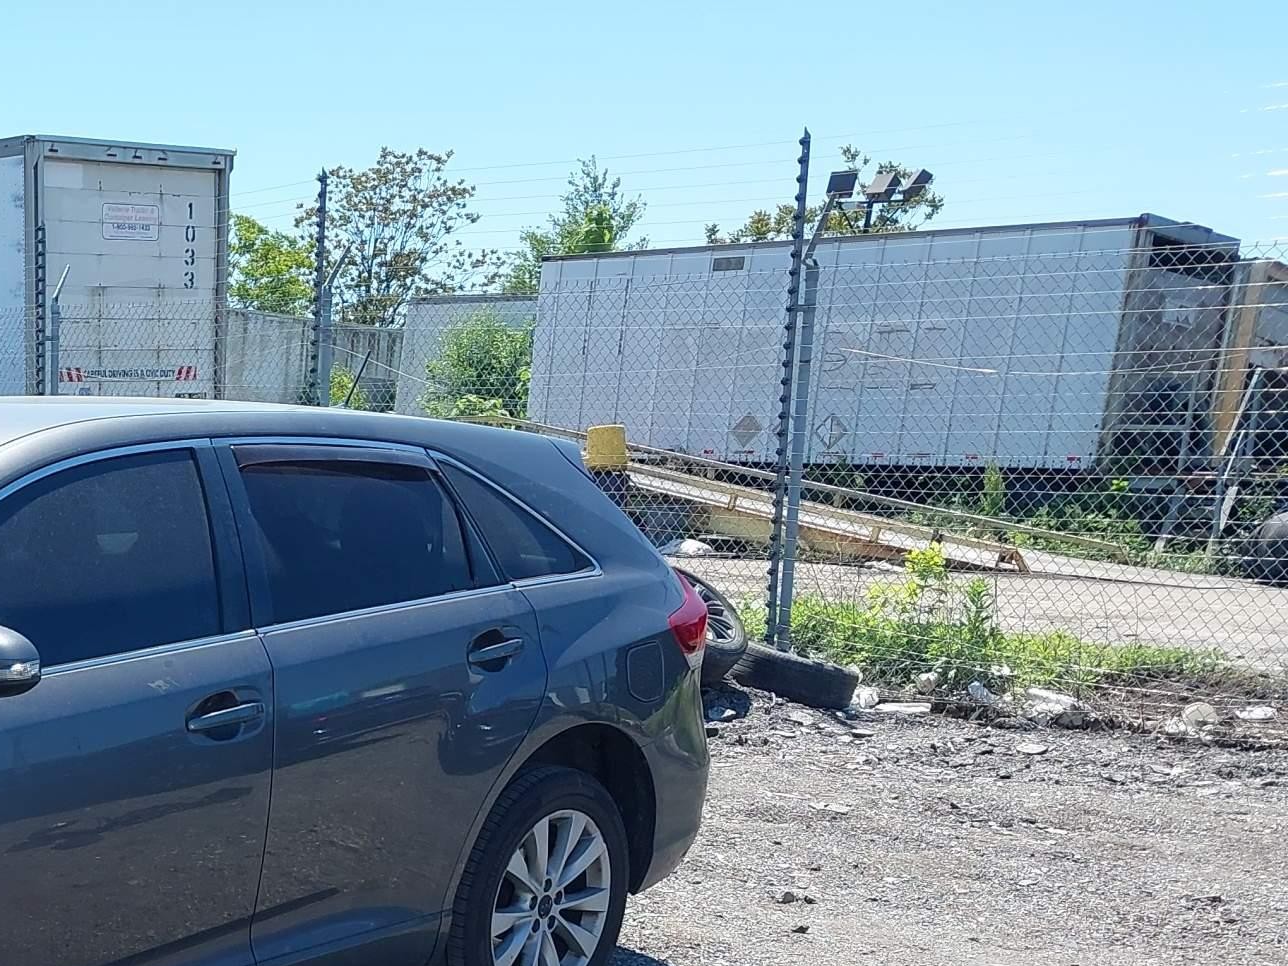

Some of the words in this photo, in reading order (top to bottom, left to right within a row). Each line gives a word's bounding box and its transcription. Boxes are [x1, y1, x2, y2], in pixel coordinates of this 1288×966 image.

[184, 202, 196, 290] 1033
[108, 369, 132, 378] DRIVING
[159, 369, 176, 378] DUTY
